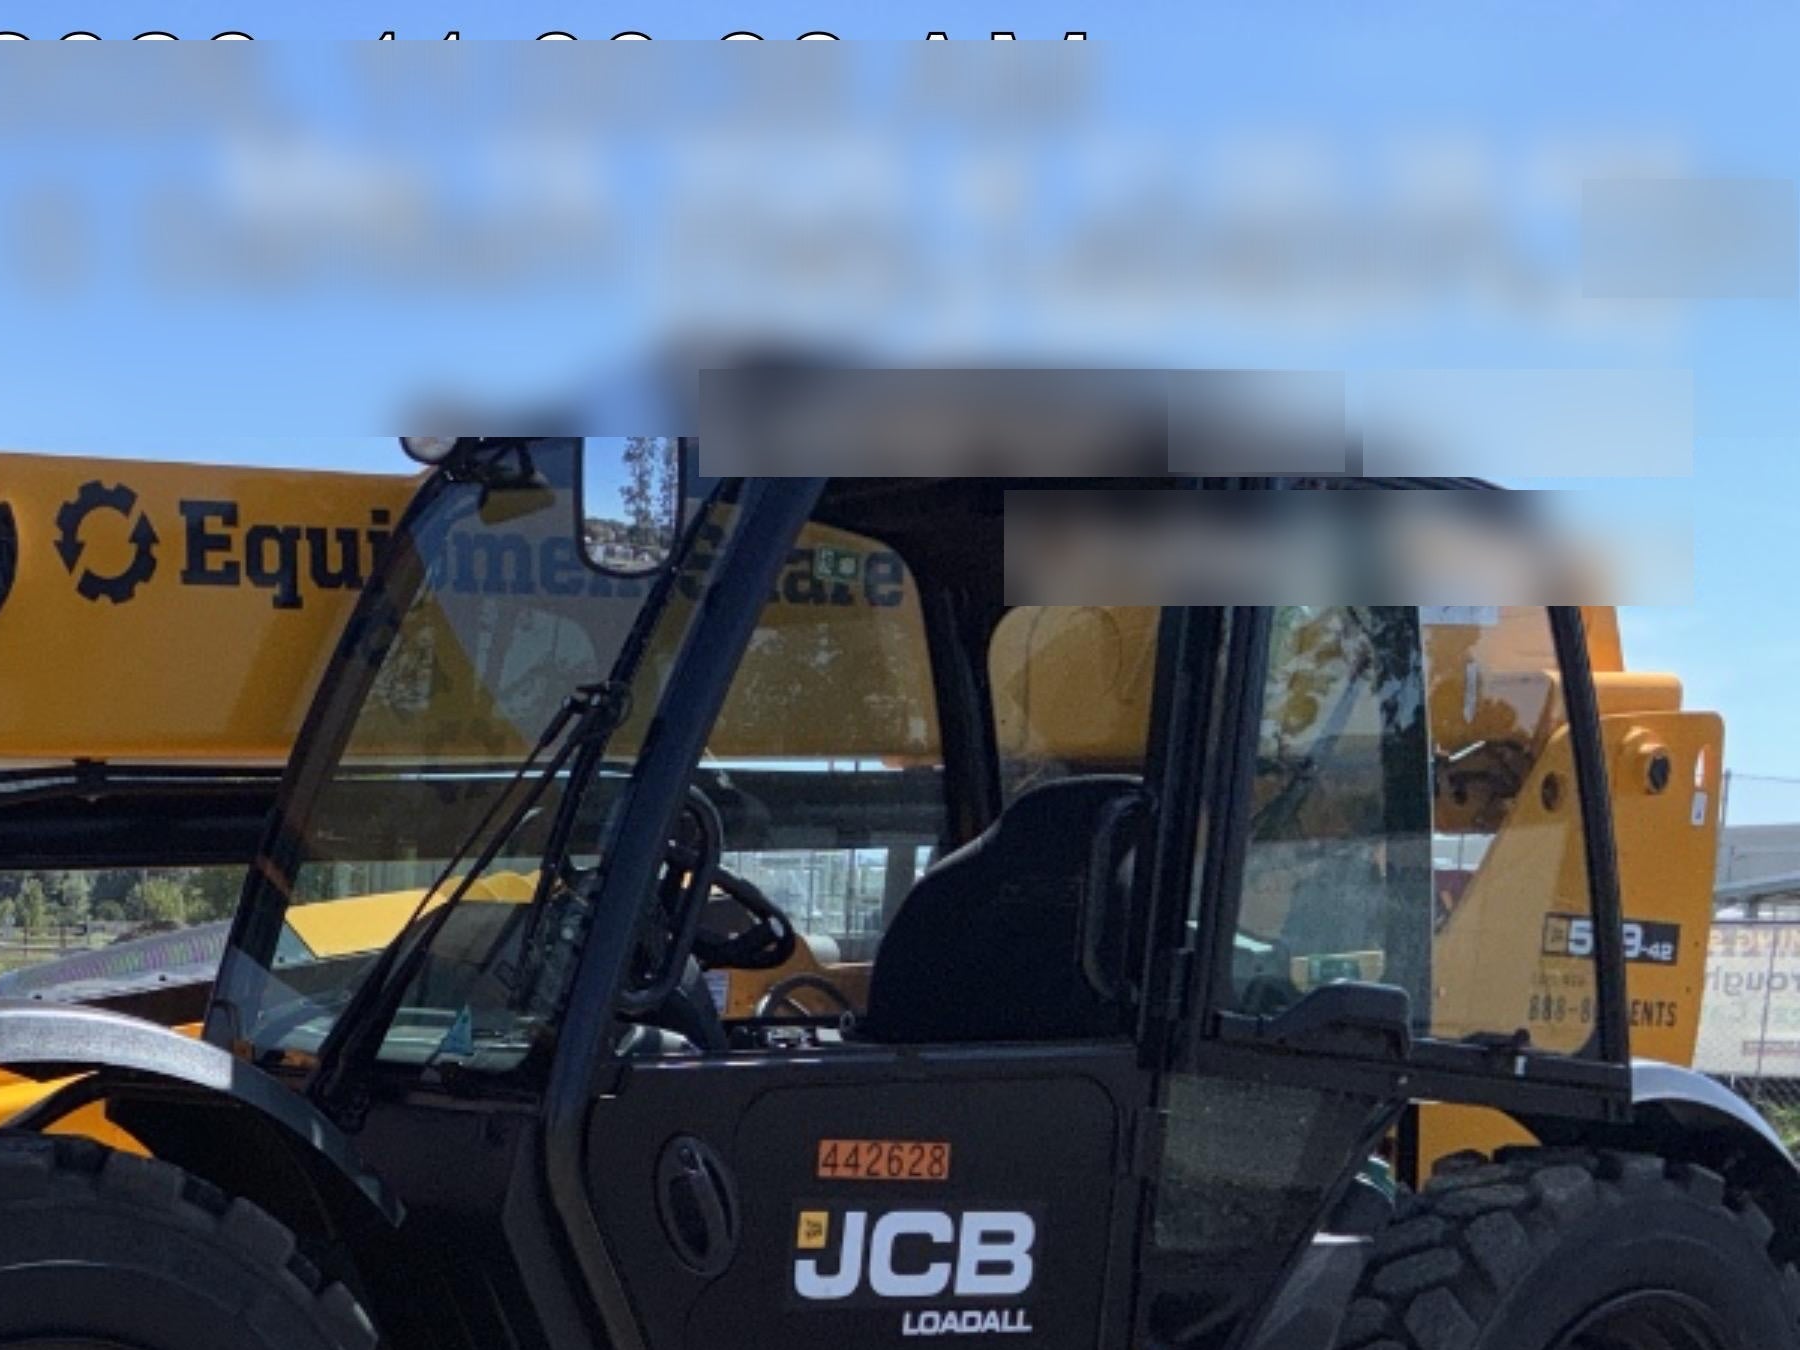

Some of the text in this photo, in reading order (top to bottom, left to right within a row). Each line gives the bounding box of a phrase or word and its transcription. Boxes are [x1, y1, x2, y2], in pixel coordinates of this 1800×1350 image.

[179, 498, 652, 609] Equime
[1567, 919, 1673, 961] 59-42
[821, 1142, 947, 1178] 442628
[794, 1211, 1036, 1299] JCB
[902, 1308, 1032, 1336] LOADALL
